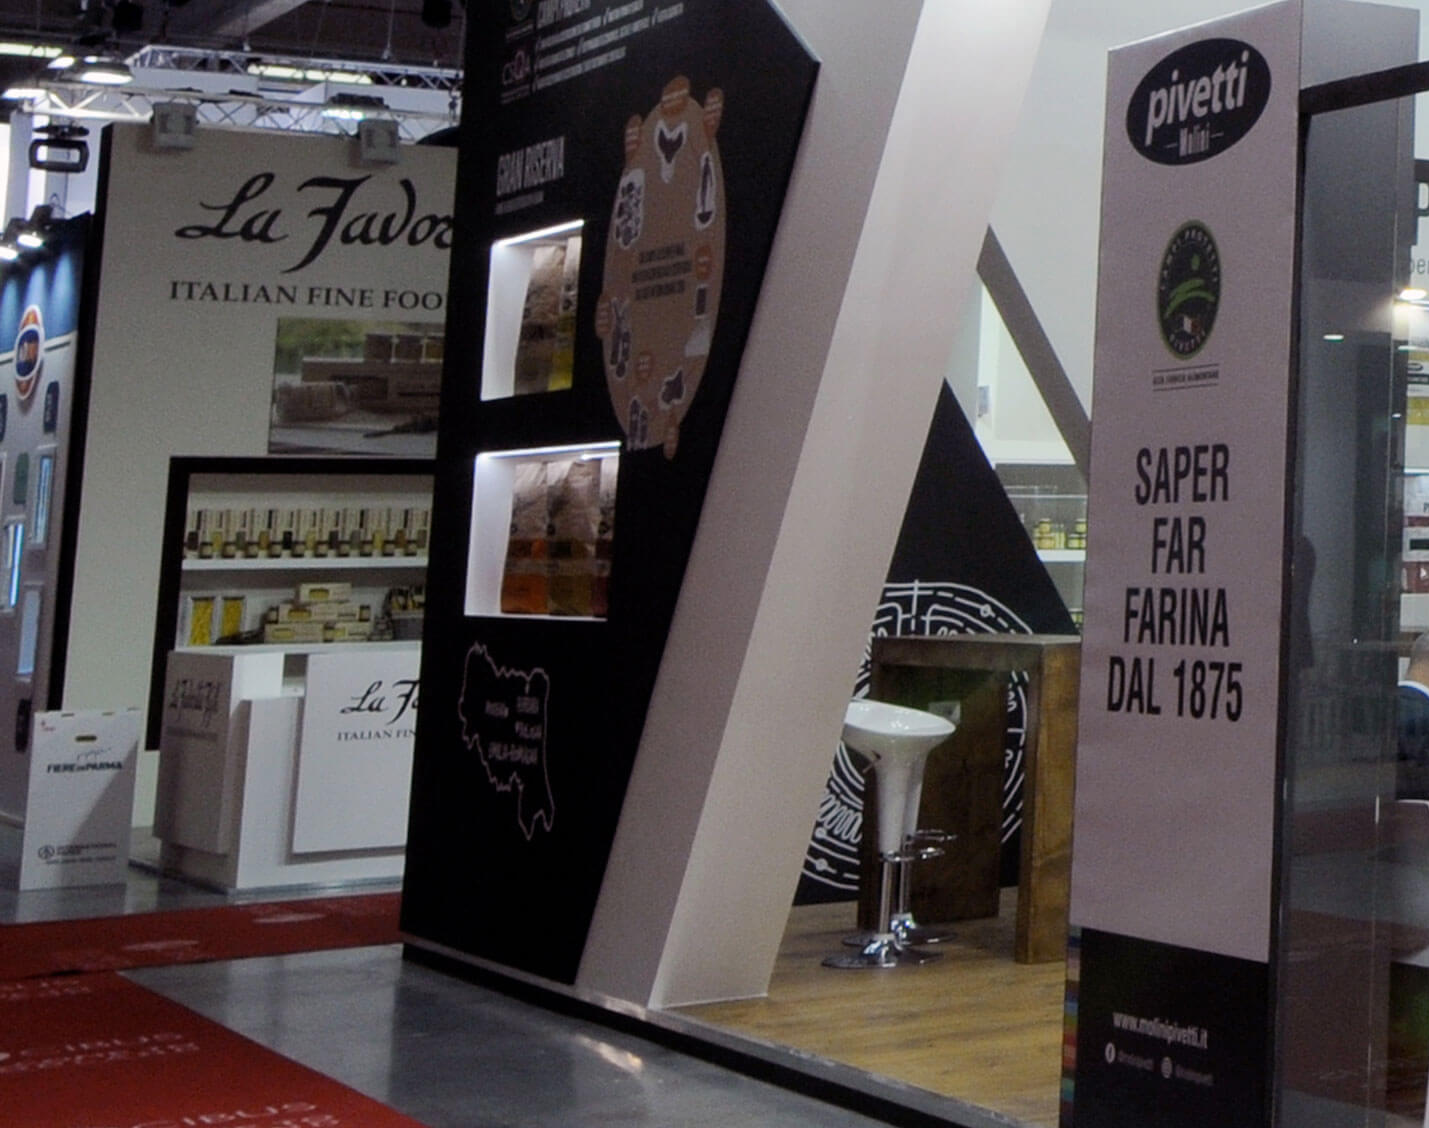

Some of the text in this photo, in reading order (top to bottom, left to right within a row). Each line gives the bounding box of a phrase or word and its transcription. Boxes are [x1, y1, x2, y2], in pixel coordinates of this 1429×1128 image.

[1144, 50, 1251, 147] pivetti
[1178, 122, 1211, 157] Molini
[174, 172, 289, 243] La
[169, 280, 298, 305] ITALIAN
[305, 286, 374, 308] FINE
[1134, 443, 1230, 505] SAPER
[1150, 516, 1207, 574] FAR
[1123, 587, 1230, 647] FARINA
[340, 680, 389, 715] La
[1106, 656, 1243, 722] DAL 1875
[338, 730, 393, 742] ITALIAN
[1112, 1011, 1209, 1050] www.molinipivetti.it
